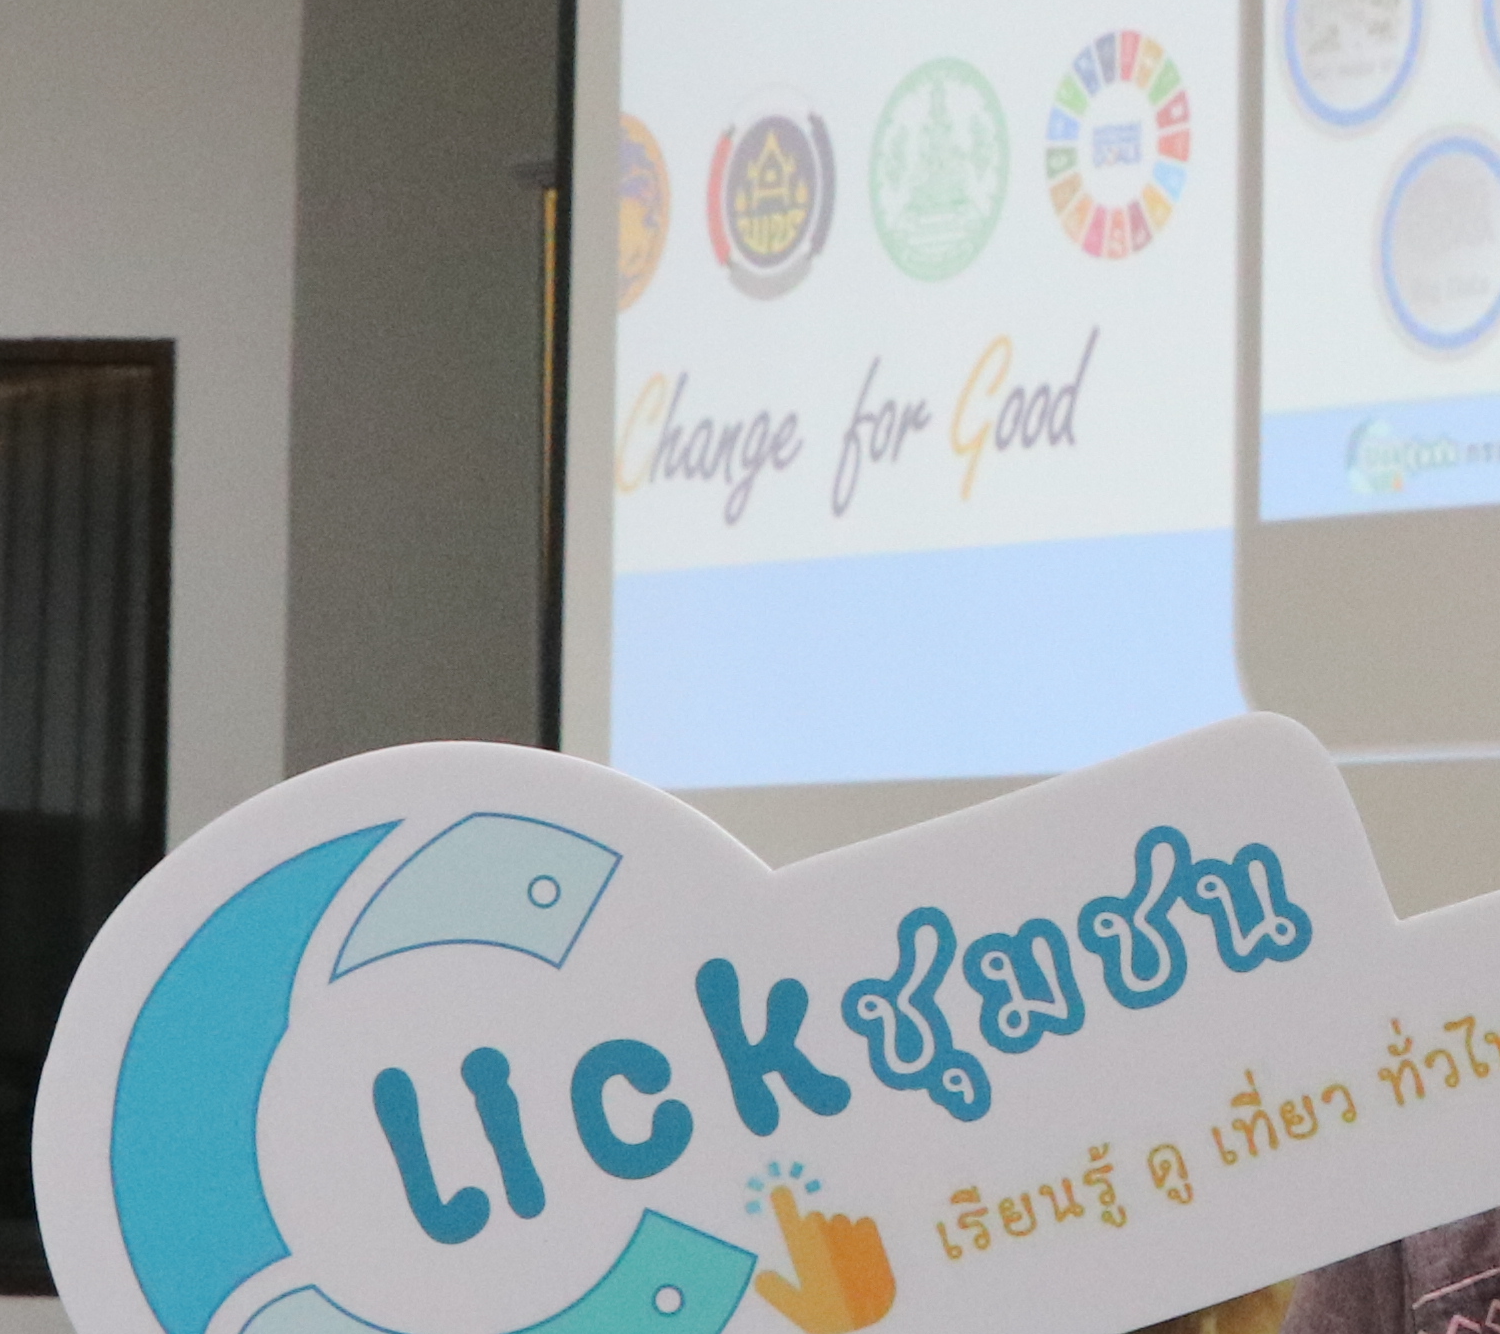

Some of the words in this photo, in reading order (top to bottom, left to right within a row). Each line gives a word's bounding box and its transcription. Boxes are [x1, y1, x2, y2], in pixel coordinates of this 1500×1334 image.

[615, 369, 803, 526] Change
[831, 356, 930, 517] for
[950, 324, 1100, 501] Good
[937, 1145, 1128, 1260] เรียนรู้
[1147, 1141, 1194, 1206] ดู
[1211, 1070, 1355, 1167] เที่ยว
